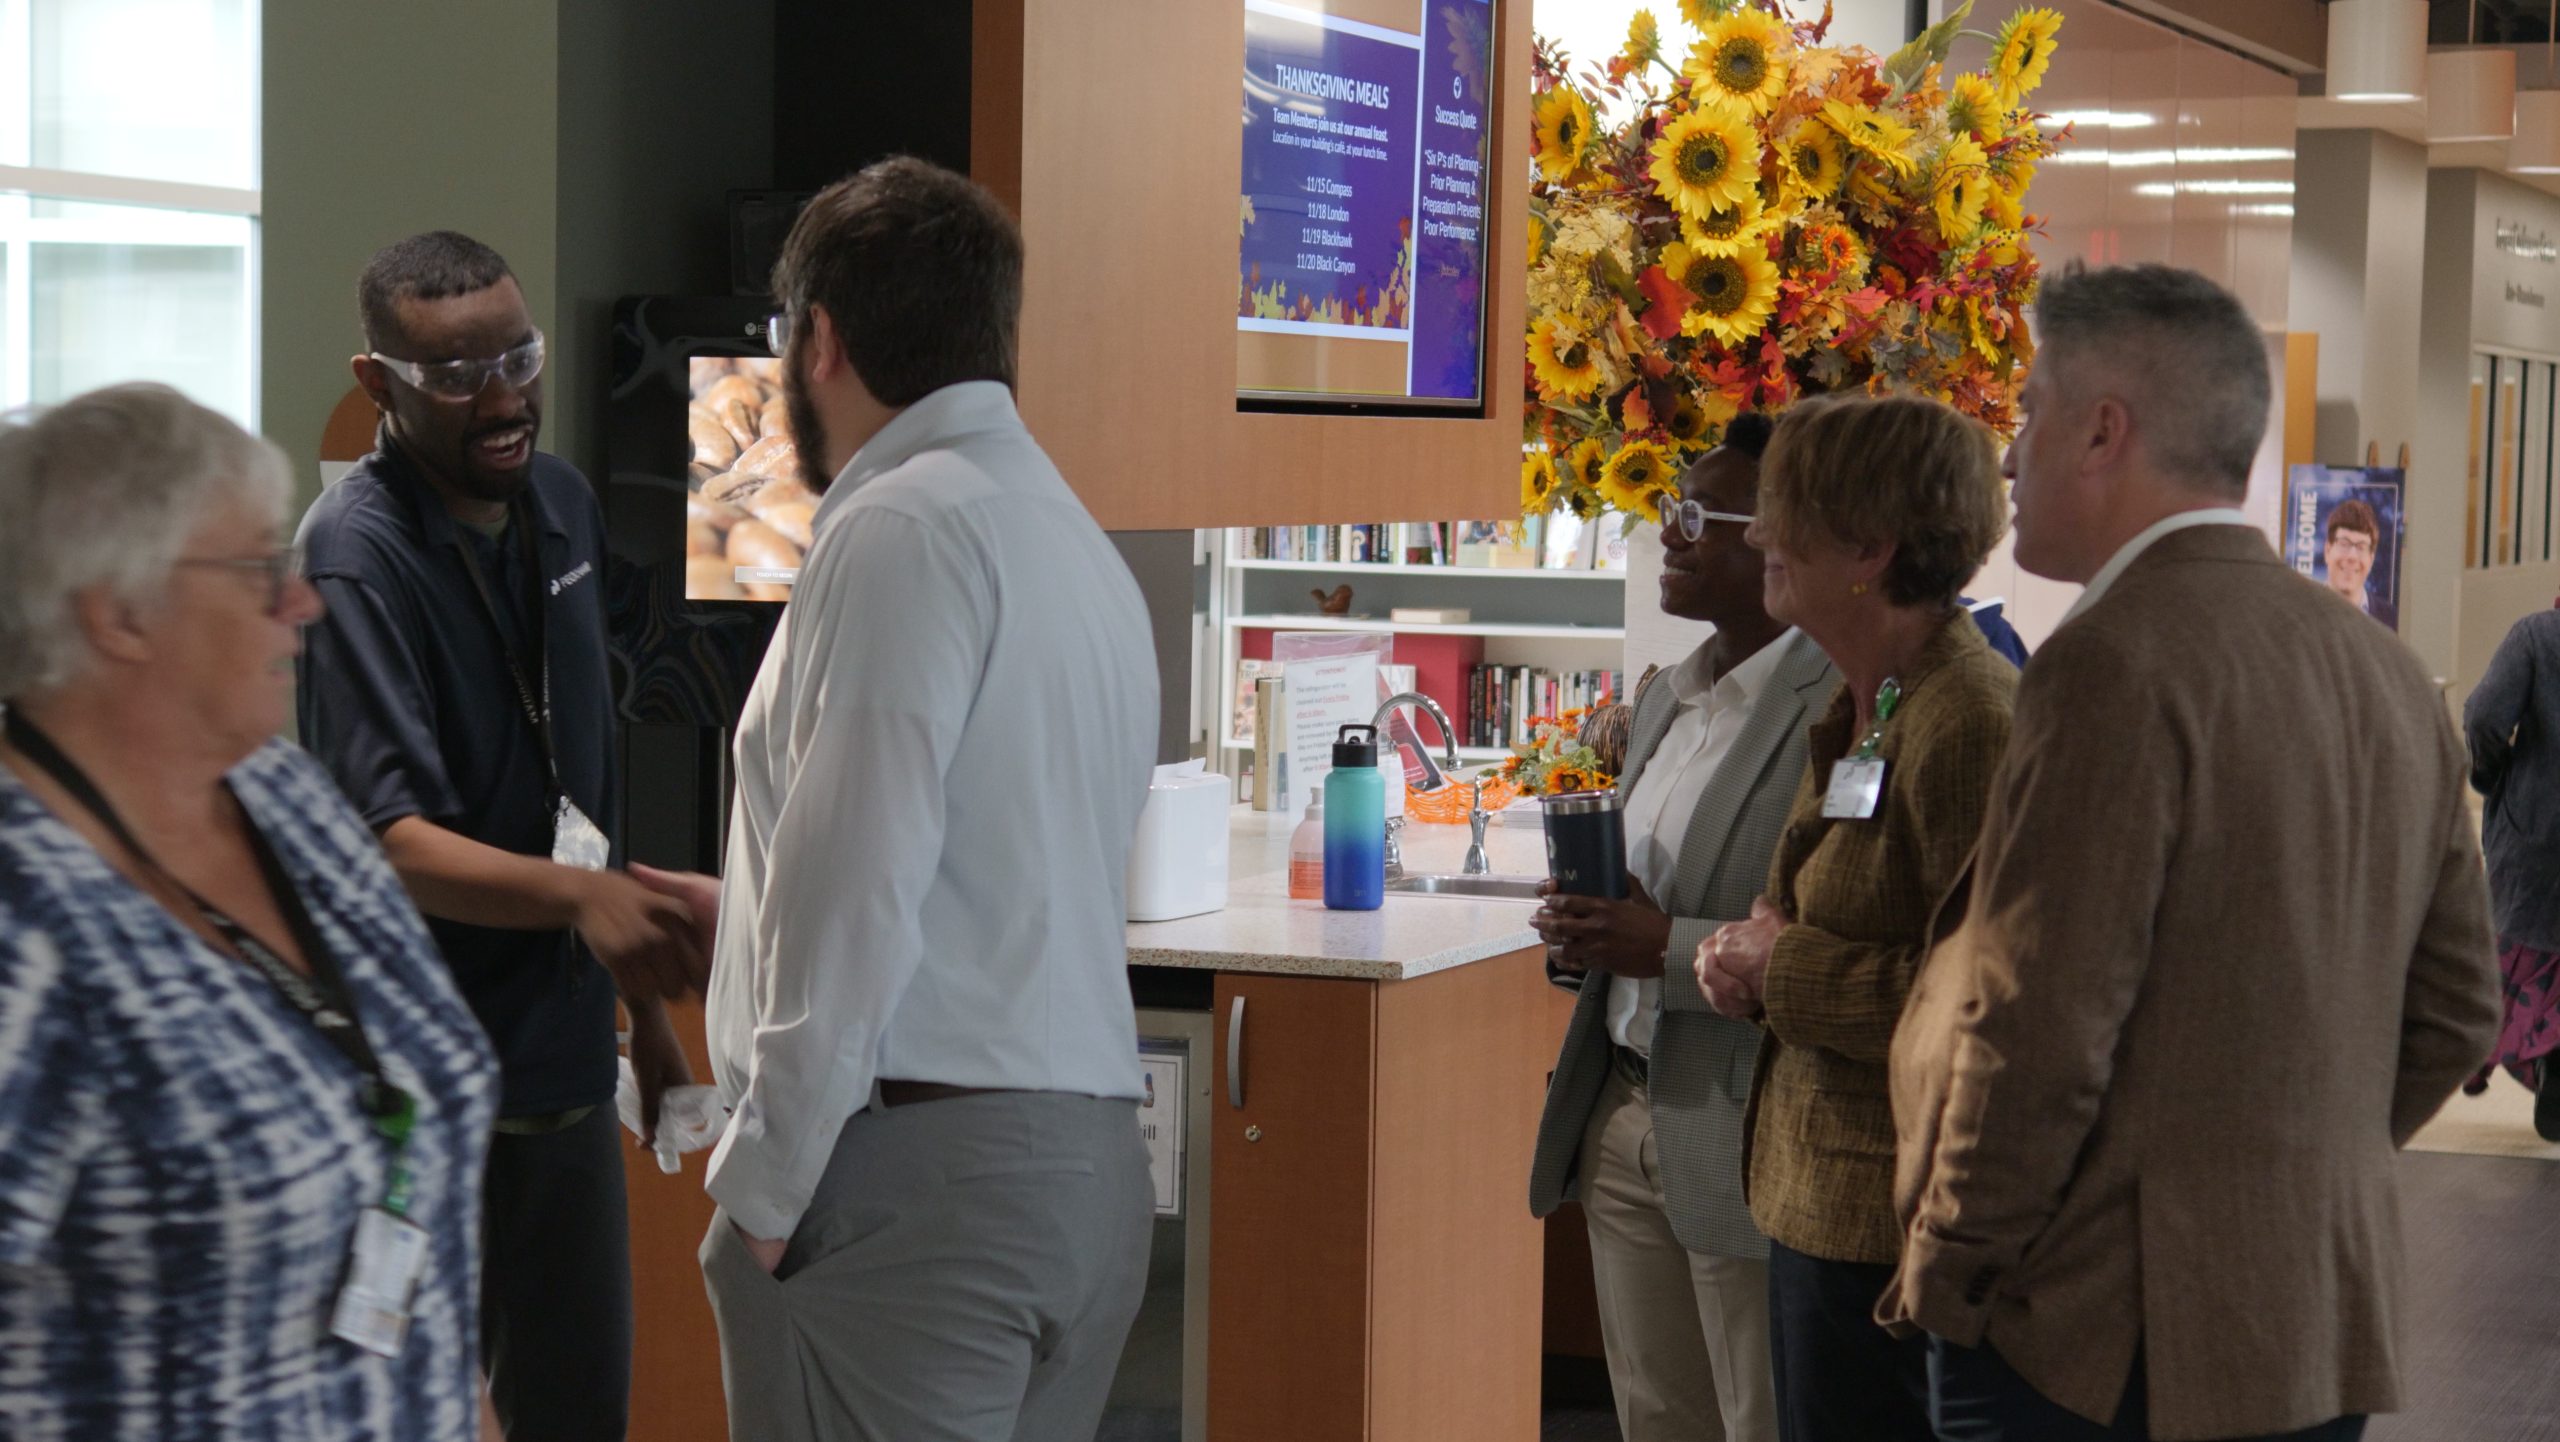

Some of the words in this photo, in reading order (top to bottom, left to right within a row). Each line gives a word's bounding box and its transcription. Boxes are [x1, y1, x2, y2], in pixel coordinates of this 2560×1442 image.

[1276, 64, 1355, 103] THANKSGIVING
[1356, 80, 1389, 109] MEALS
[1273, 107, 1290, 124] Team
[1290, 110, 1318, 130] Members
[1317, 115, 1329, 133] join
[1329, 119, 1337, 133] us
[1336, 121, 1344, 135] at
[1344, 123, 1355, 136] our
[1354, 125, 1373, 139] annual
[1373, 125, 1389, 142] feast.
[1435, 104, 1459, 127] Success
[1460, 109, 1477, 130] Quote
[1273, 129, 1295, 145] Location
[1294, 132, 1300, 146] in
[1300, 137, 1312, 149] your
[1352, 145, 1363, 158] your
[1363, 143, 1376, 158] lunch
[1376, 146, 1388, 160] time.
[1437, 151, 1446, 168] P's
[1447, 152, 1454, 169] of
[1454, 154, 1479, 177] Planning
[1307, 176, 1326, 193] 11/15
[1326, 178, 1352, 198] Compass
[1430, 173, 1445, 191] Prior
[1445, 176, 1471, 198] Planning
[1471, 180, 1476, 196] &
[1308, 202, 1326, 219] 11/18
[1327, 204, 1350, 222] London
[1422, 196, 1456, 216] Preparation
[1457, 200, 1482, 219] Prevents
[1302, 227, 1321, 244] 11/19
[1321, 229, 1353, 248] Blackhawk
[1424, 219, 1439, 236] Poor
[1297, 252, 1316, 270] 11/20
[1316, 254, 1333, 272] Black
[1333, 256, 1356, 276] Canyon
[2297, 491, 2318, 576] ELCOME
